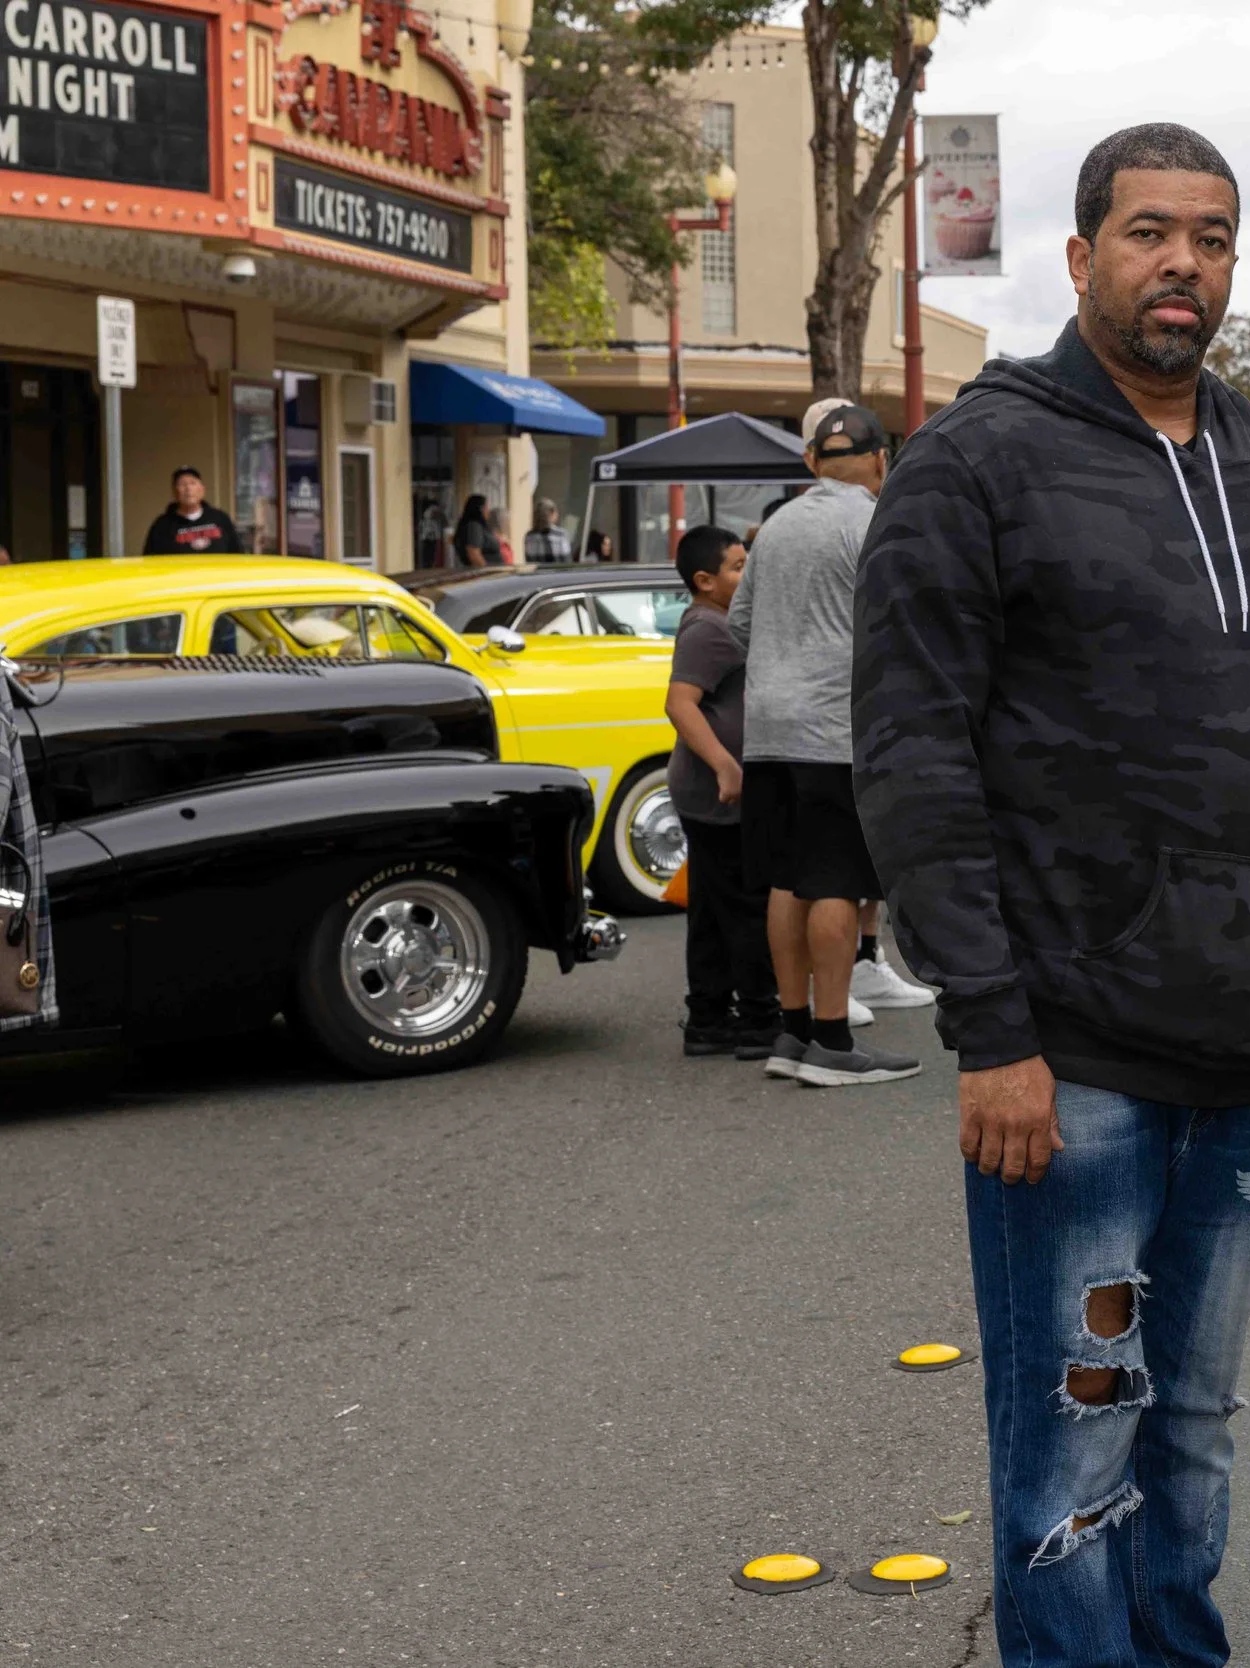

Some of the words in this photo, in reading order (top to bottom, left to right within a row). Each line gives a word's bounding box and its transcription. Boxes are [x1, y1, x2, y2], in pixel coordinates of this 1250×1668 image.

[5, 1, 197, 75] CARROLL
[8, 55, 135, 122] NIGHT
[296, 179, 372, 239] TICKETS:
[376, 202, 449, 259] 757-9500
[347, 862, 415, 907] Radial
[425, 861, 457, 877] T/A
[368, 1000, 496, 1056] BFGoodrich
